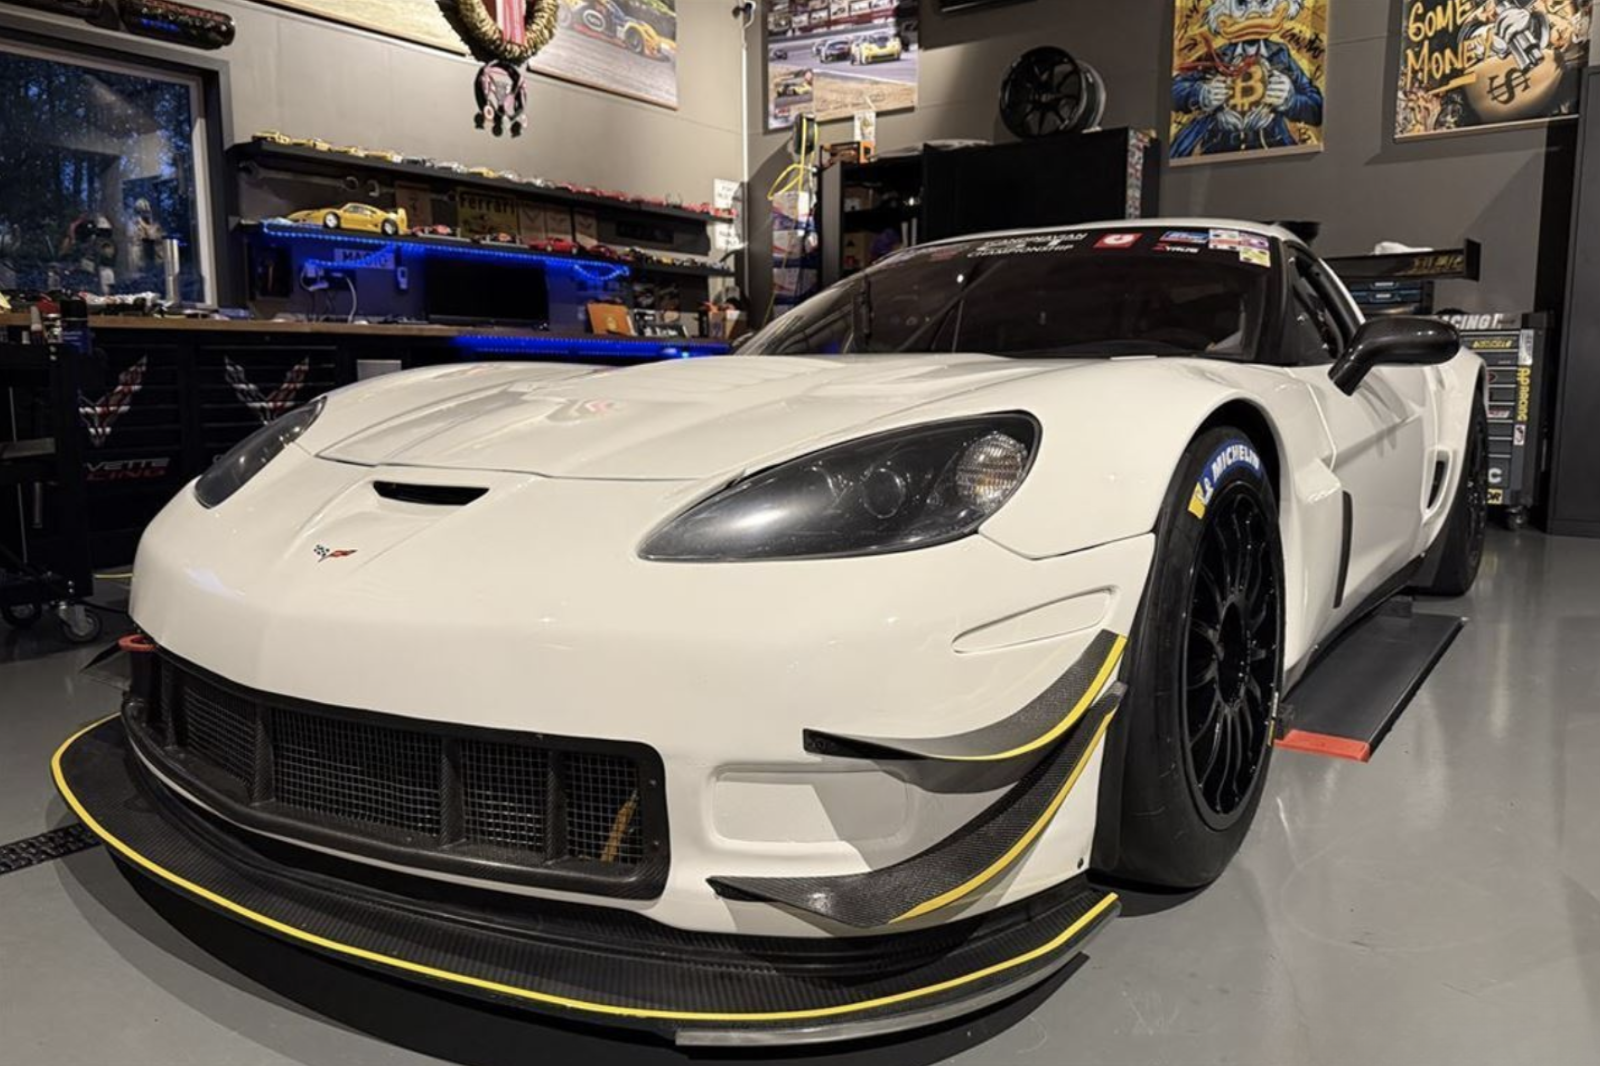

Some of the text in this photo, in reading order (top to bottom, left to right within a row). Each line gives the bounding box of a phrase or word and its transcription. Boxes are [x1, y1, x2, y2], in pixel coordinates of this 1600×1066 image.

[1405, 29, 1494, 89] MONEY
[460, 191, 517, 217] Ferrari
[967, 244, 1075, 258] CHAMPIONSHIP
[86, 457, 169, 472] VETTE
[1211, 444, 1260, 484] MICHELIN
